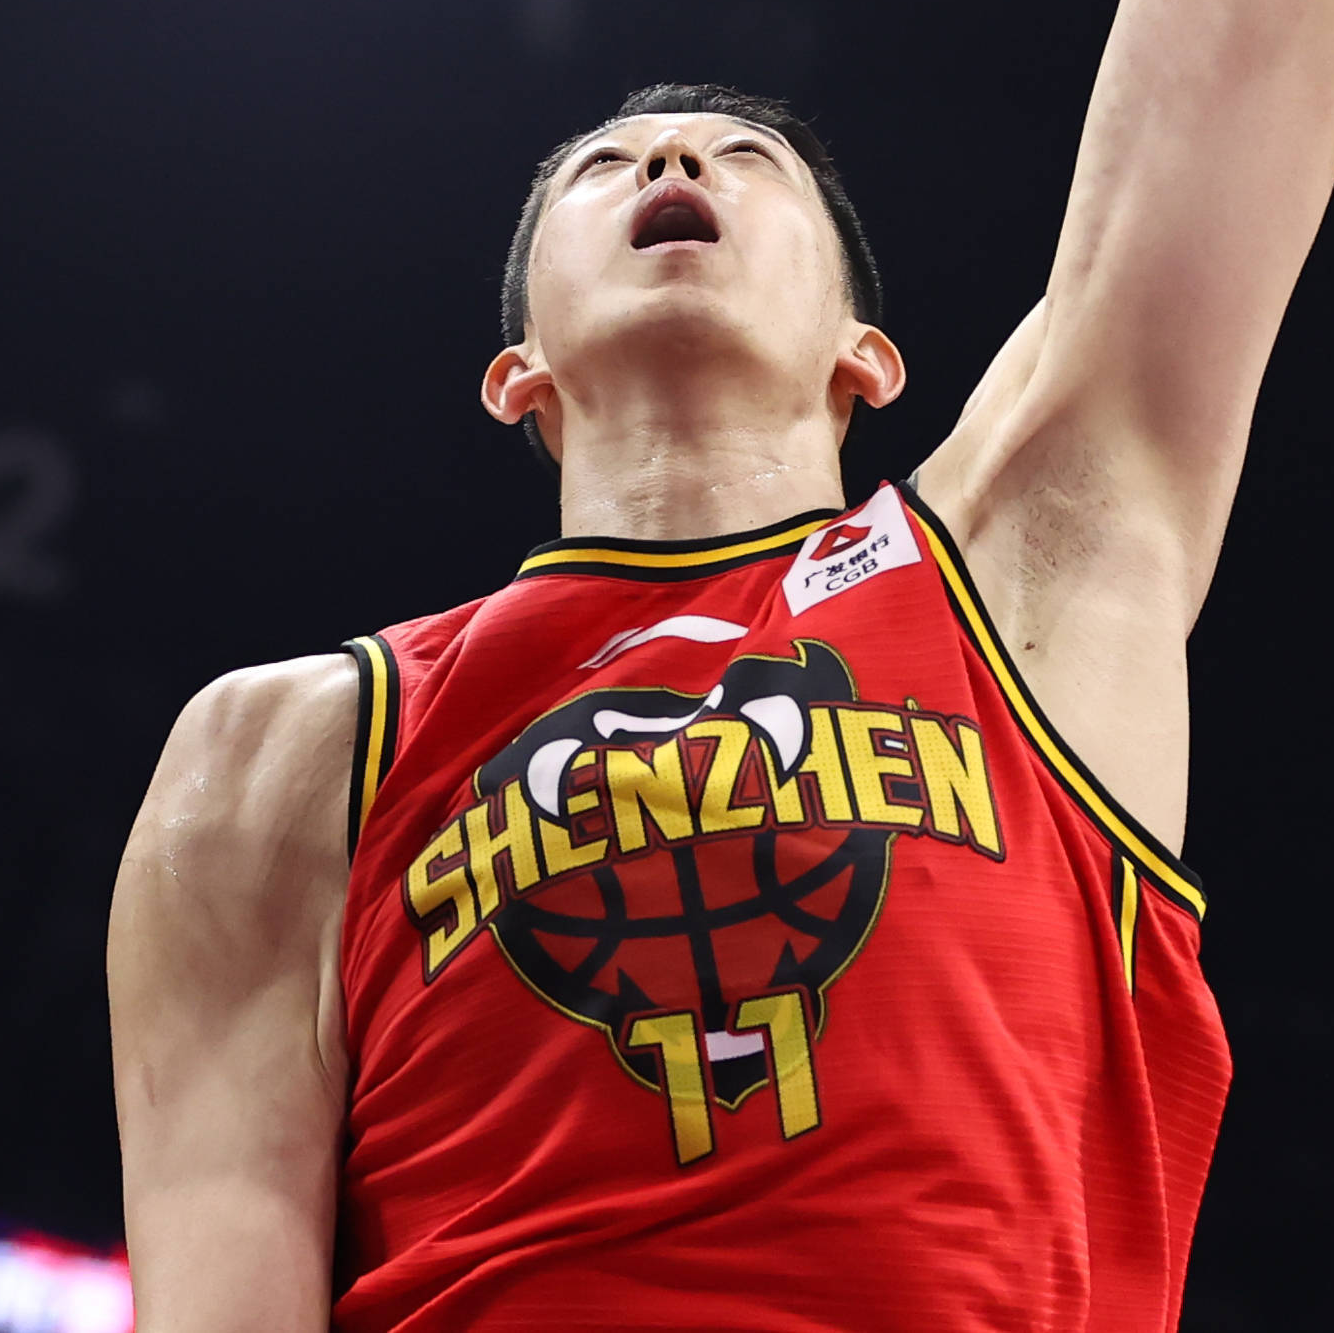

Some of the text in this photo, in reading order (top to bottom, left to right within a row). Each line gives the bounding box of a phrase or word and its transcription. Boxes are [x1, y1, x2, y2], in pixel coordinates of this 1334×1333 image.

[803, 533, 890, 589] 广发银行
[825, 557, 880, 592] CGB
[405, 700, 1005, 982] SHENZHEN
[625, 988, 823, 1166] 11
